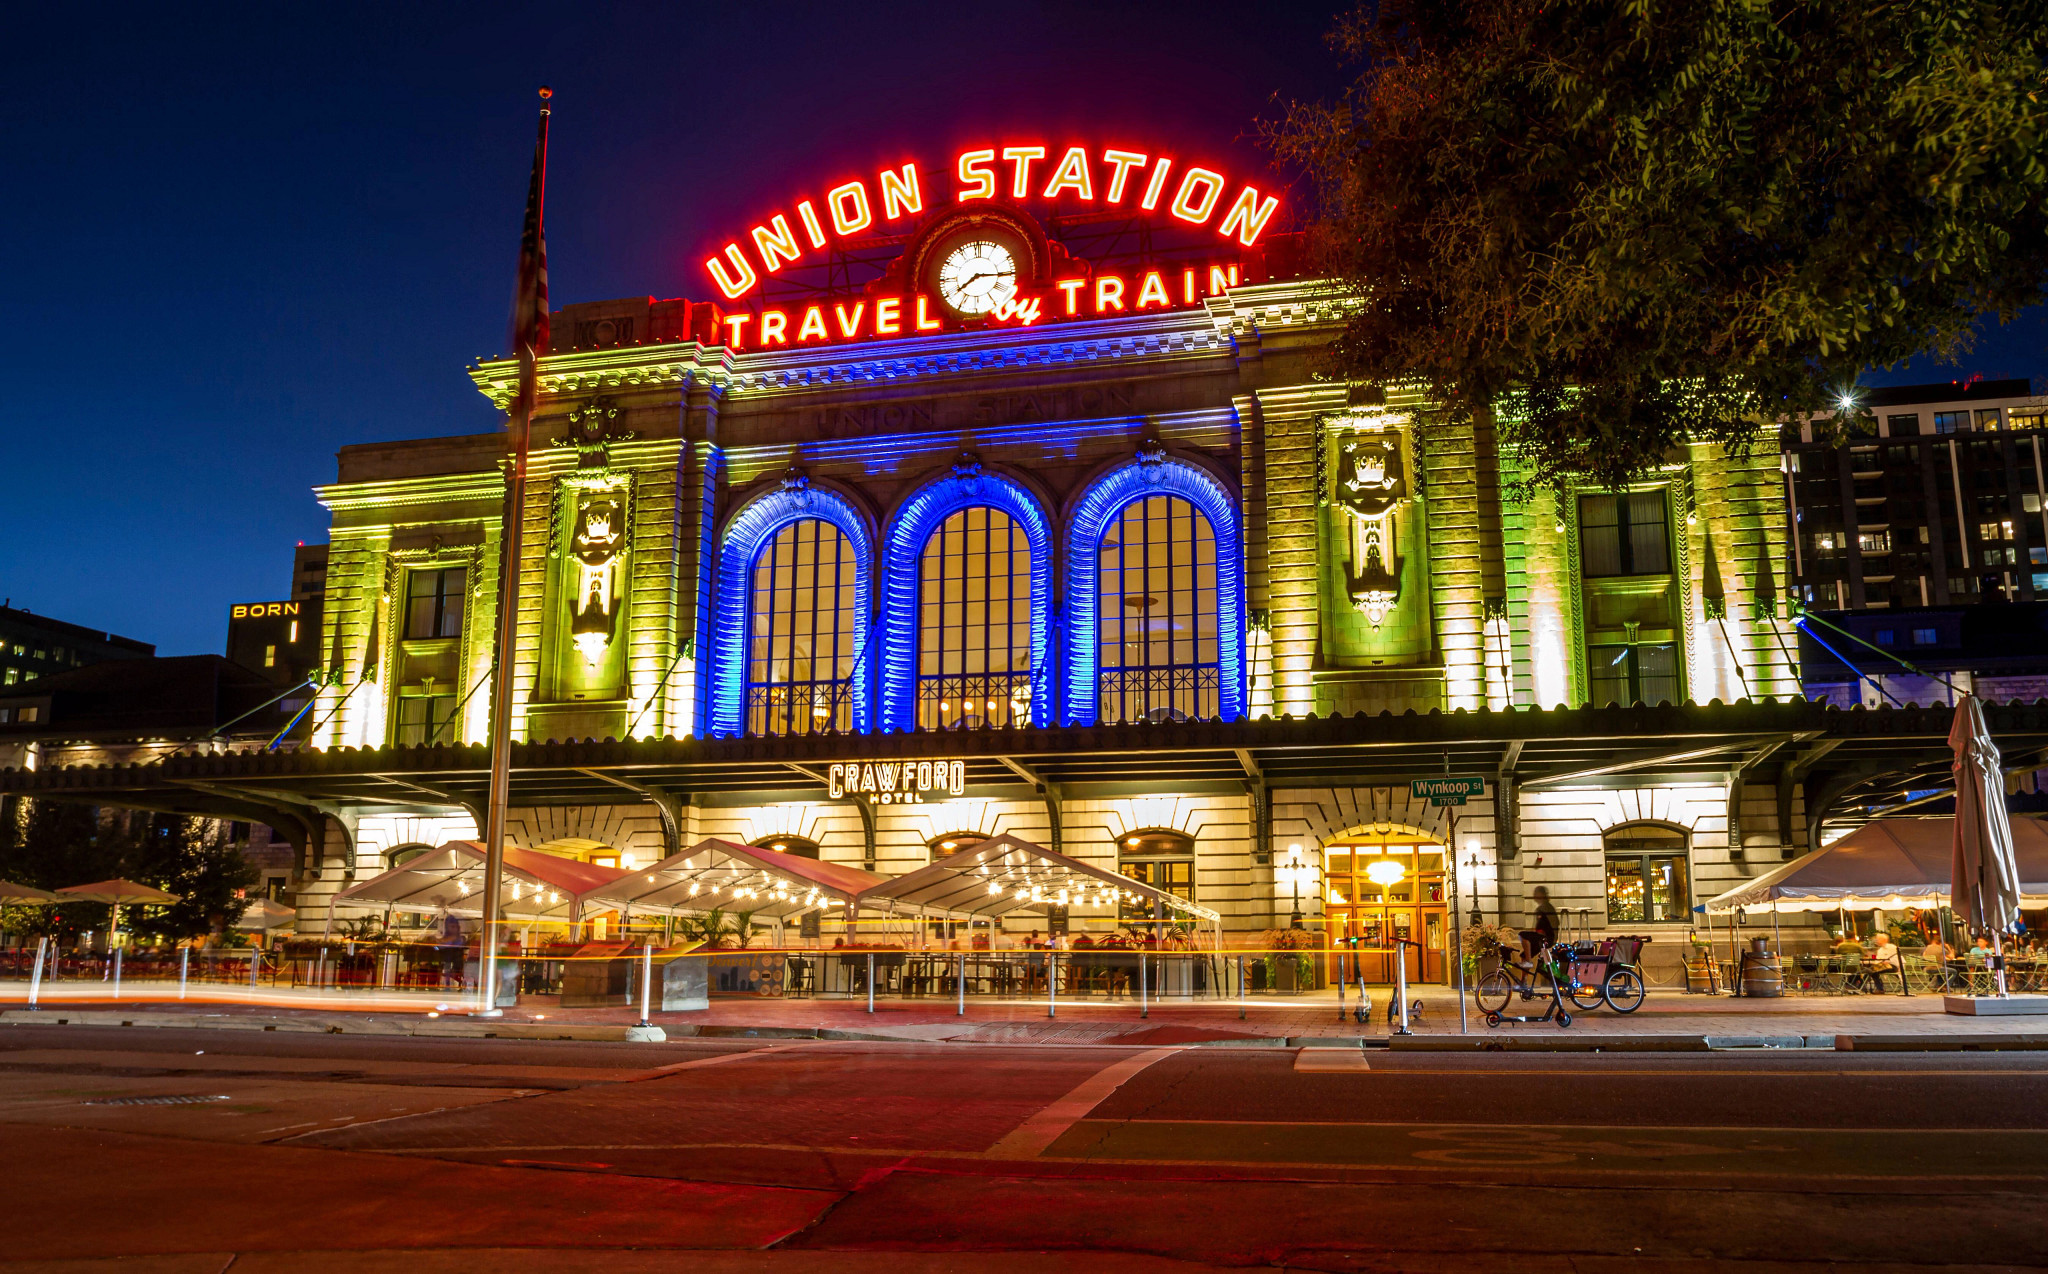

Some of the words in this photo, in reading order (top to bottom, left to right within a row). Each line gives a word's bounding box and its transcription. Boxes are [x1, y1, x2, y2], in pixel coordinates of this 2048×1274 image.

[706, 163, 922, 299] UNION
[958, 146, 1279, 247] STATION
[723, 297, 941, 348] TRAVEL
[990, 284, 1042, 326] by
[1057, 264, 1239, 316] TRAIN
[817, 402, 934, 432] UNION
[974, 385, 1135, 421] STATION
[233, 602, 299, 618] BORN
[829, 760, 965, 799] CRAWFORD
[1416, 781, 1470, 796] Wynkoop
[869, 792, 924, 804] HOTEL
[1440, 798, 1459, 806] 1700
